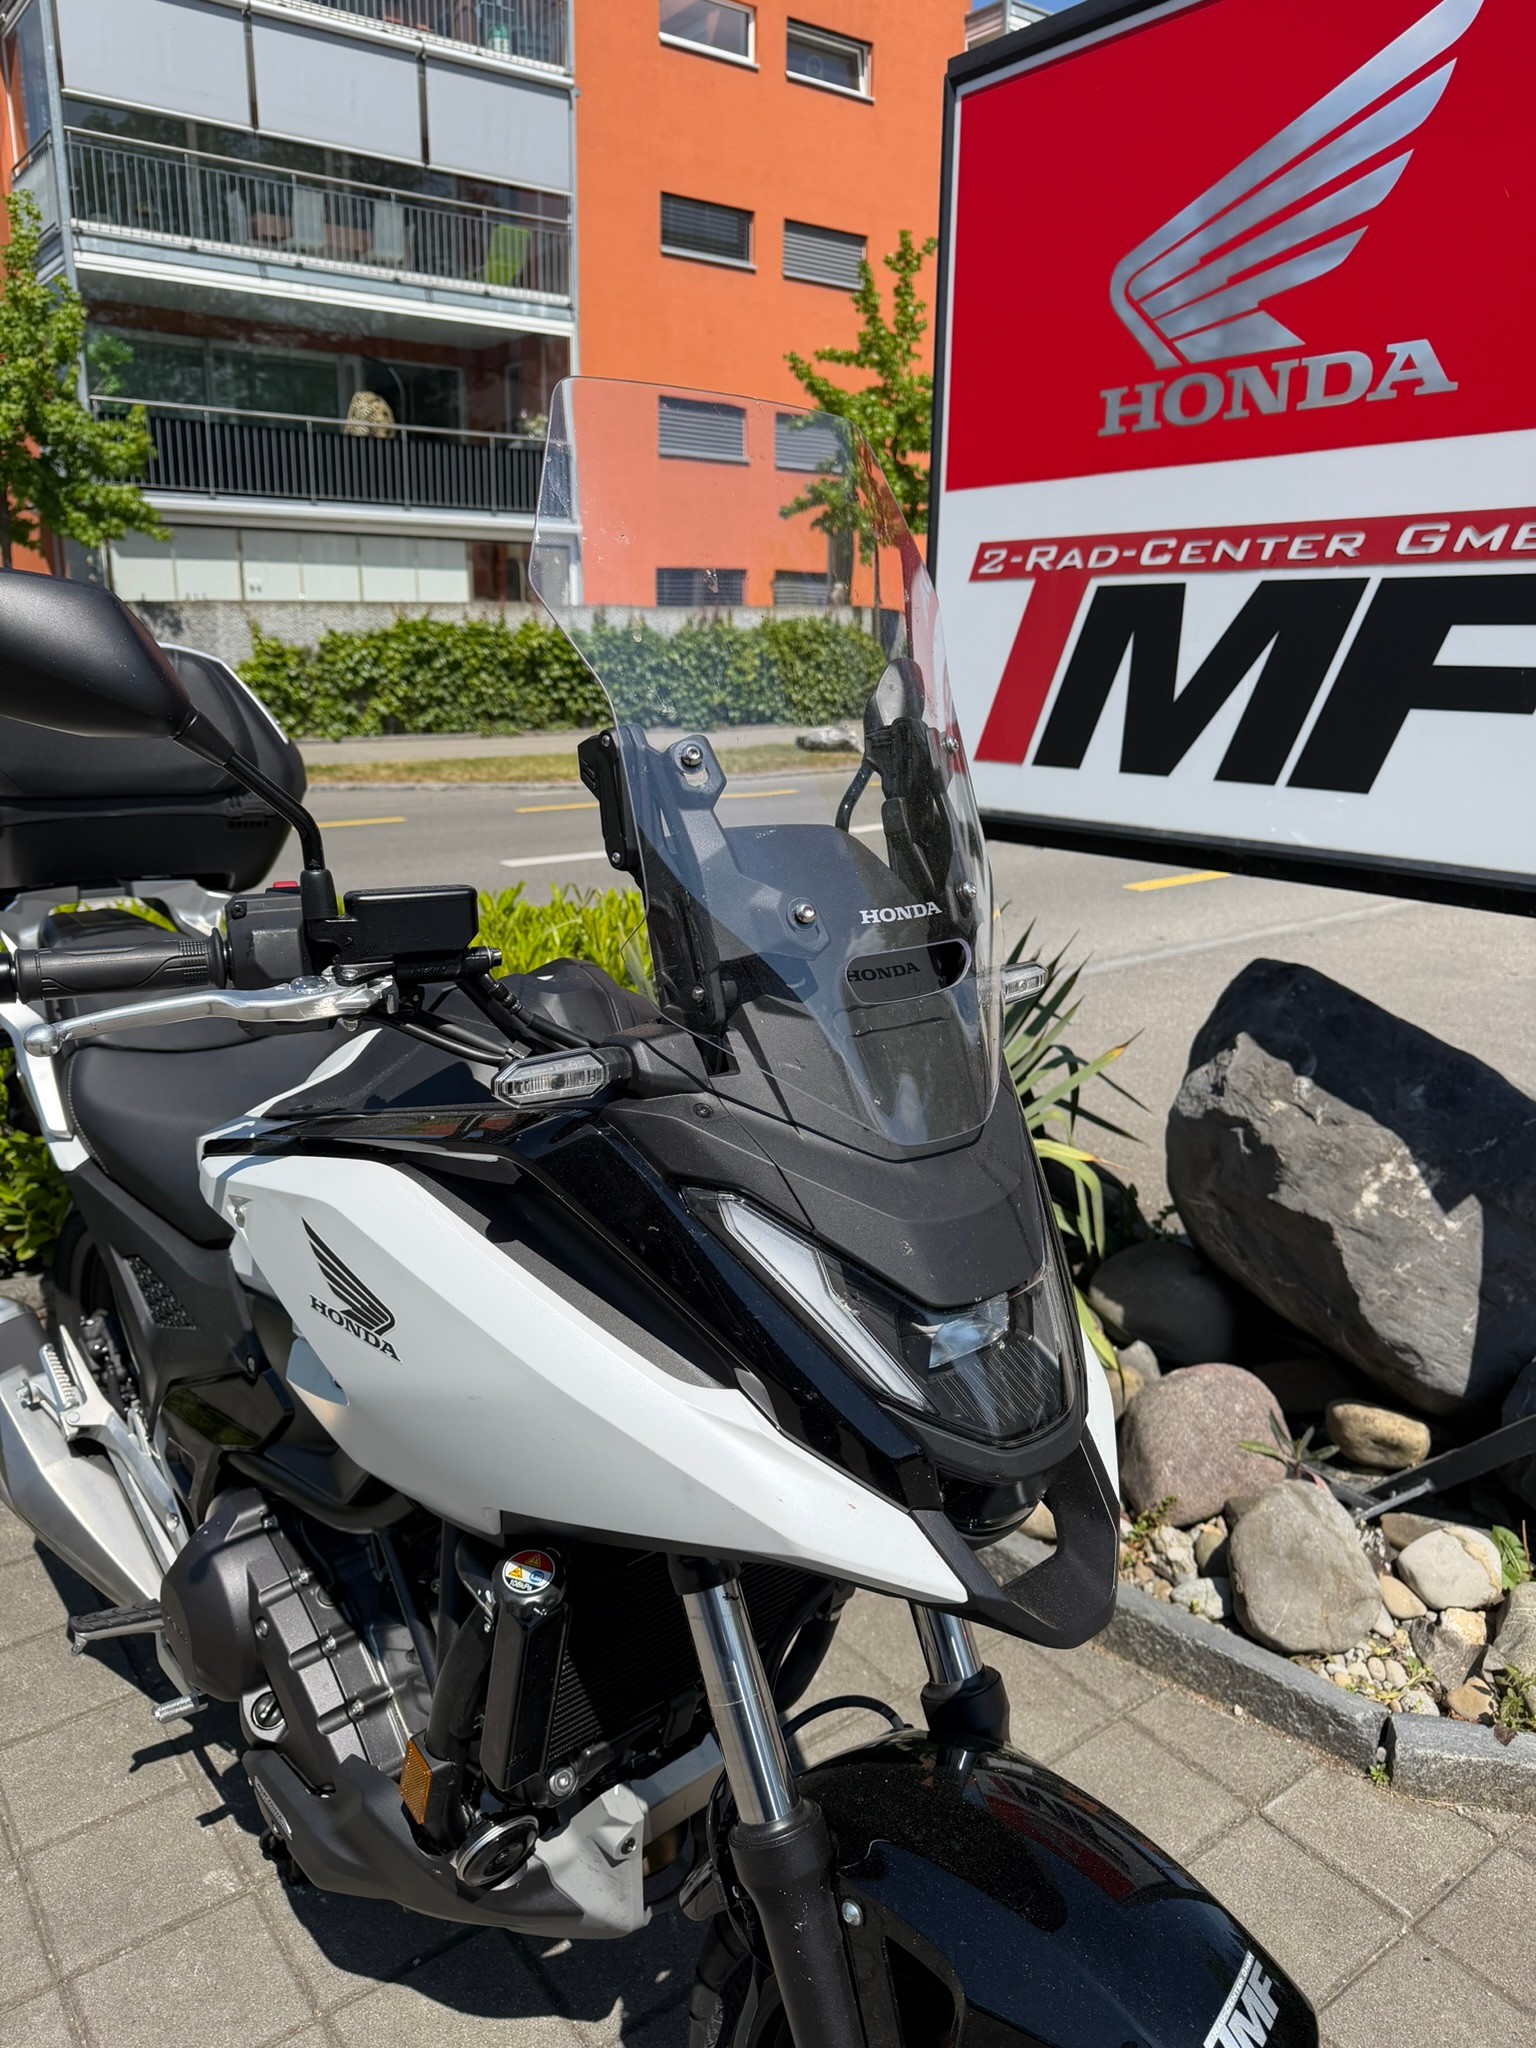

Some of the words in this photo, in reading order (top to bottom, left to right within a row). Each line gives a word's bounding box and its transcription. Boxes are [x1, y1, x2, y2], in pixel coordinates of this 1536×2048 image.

[1098, 339, 1459, 437] HONDA
[972, 574, 1536, 795] TMF
[859, 901, 943, 925] HONDA
[847, 962, 921, 982] HONDA
[309, 1293, 402, 1363] HONDA
[1212, 1958, 1280, 2048] TMF
